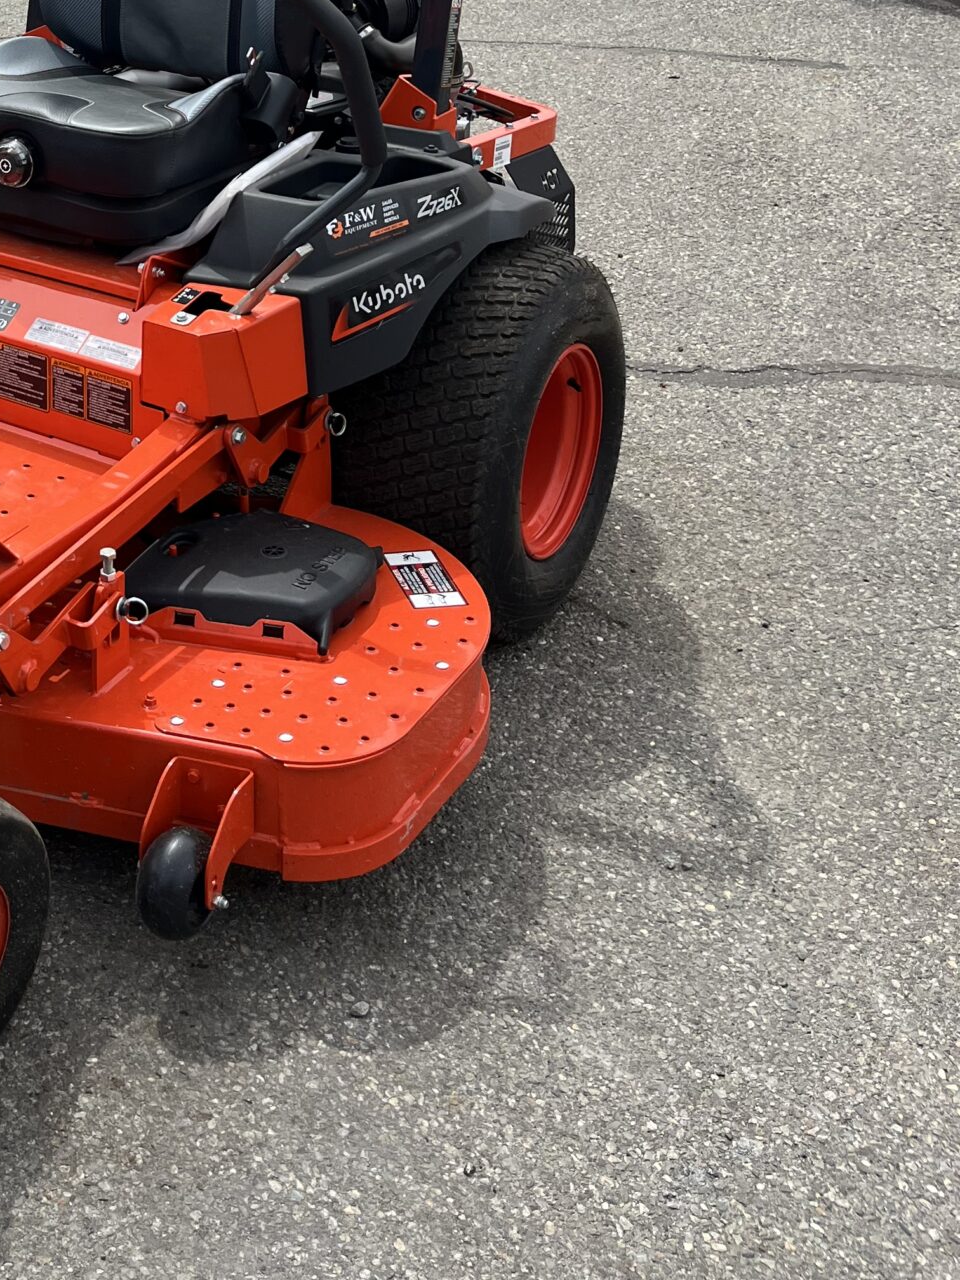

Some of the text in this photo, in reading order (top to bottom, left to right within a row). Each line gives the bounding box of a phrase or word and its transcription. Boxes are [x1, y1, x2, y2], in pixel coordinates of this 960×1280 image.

[343, 204, 376, 228] F&W
[417, 187, 462, 218] Z726X
[344, 219, 378, 235] EQUIPMENT
[352, 272, 426, 314] Kubota
